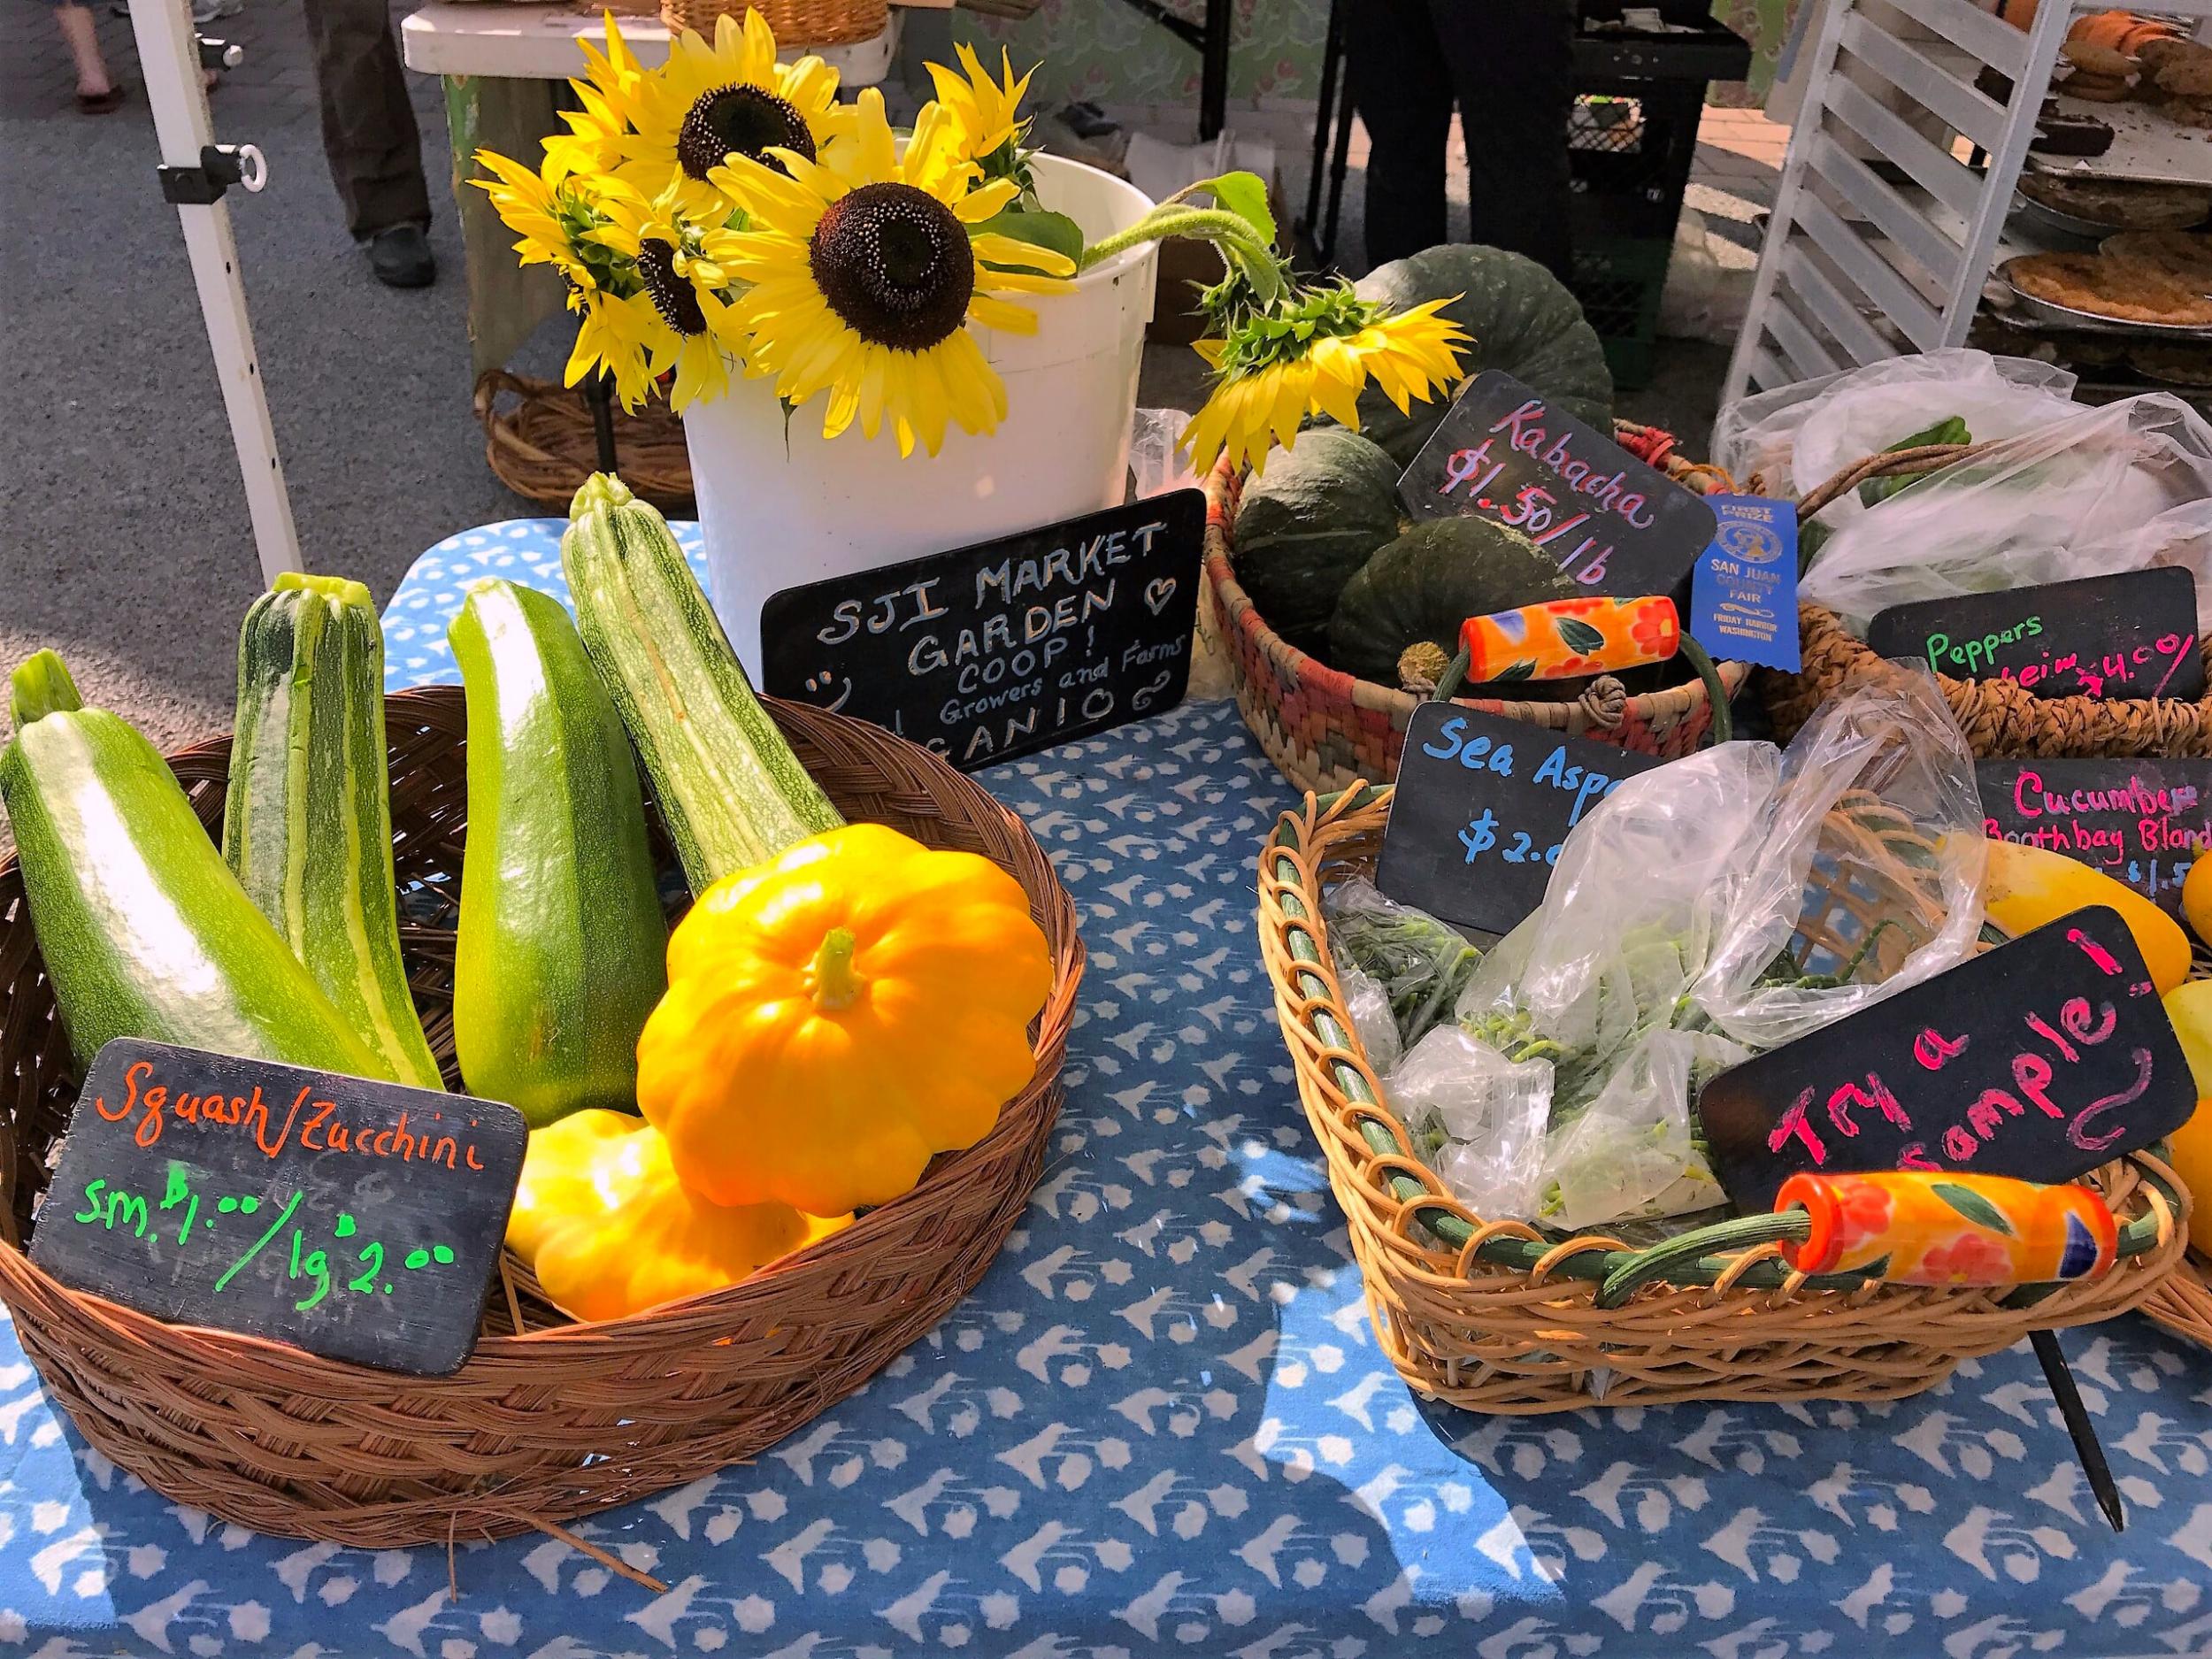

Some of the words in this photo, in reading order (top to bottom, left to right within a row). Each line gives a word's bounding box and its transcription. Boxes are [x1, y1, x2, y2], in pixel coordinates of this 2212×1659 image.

[1488, 399, 1655, 530] Kabacha
[816, 576, 949, 645] SJI
[974, 520, 1169, 611] MARKET
[1710, 558, 1740, 575] SAN
[1744, 567, 1782, 585] JUAN
[1729, 589, 1762, 603] FAIR
[907, 578, 1117, 676] GARDEN
[1713, 612, 1742, 625] FRIDAY
[1745, 618, 1778, 632] HARBOR
[1718, 625, 1772, 642] WASHINGTON
[1925, 615, 2045, 673] Peppers
[939, 676, 1044, 726] Growers
[1059, 657, 1110, 689] and
[1121, 634, 1187, 672] Farms
[1422, 717, 1515, 778] Sea
[1913, 1026, 1971, 1071] a
